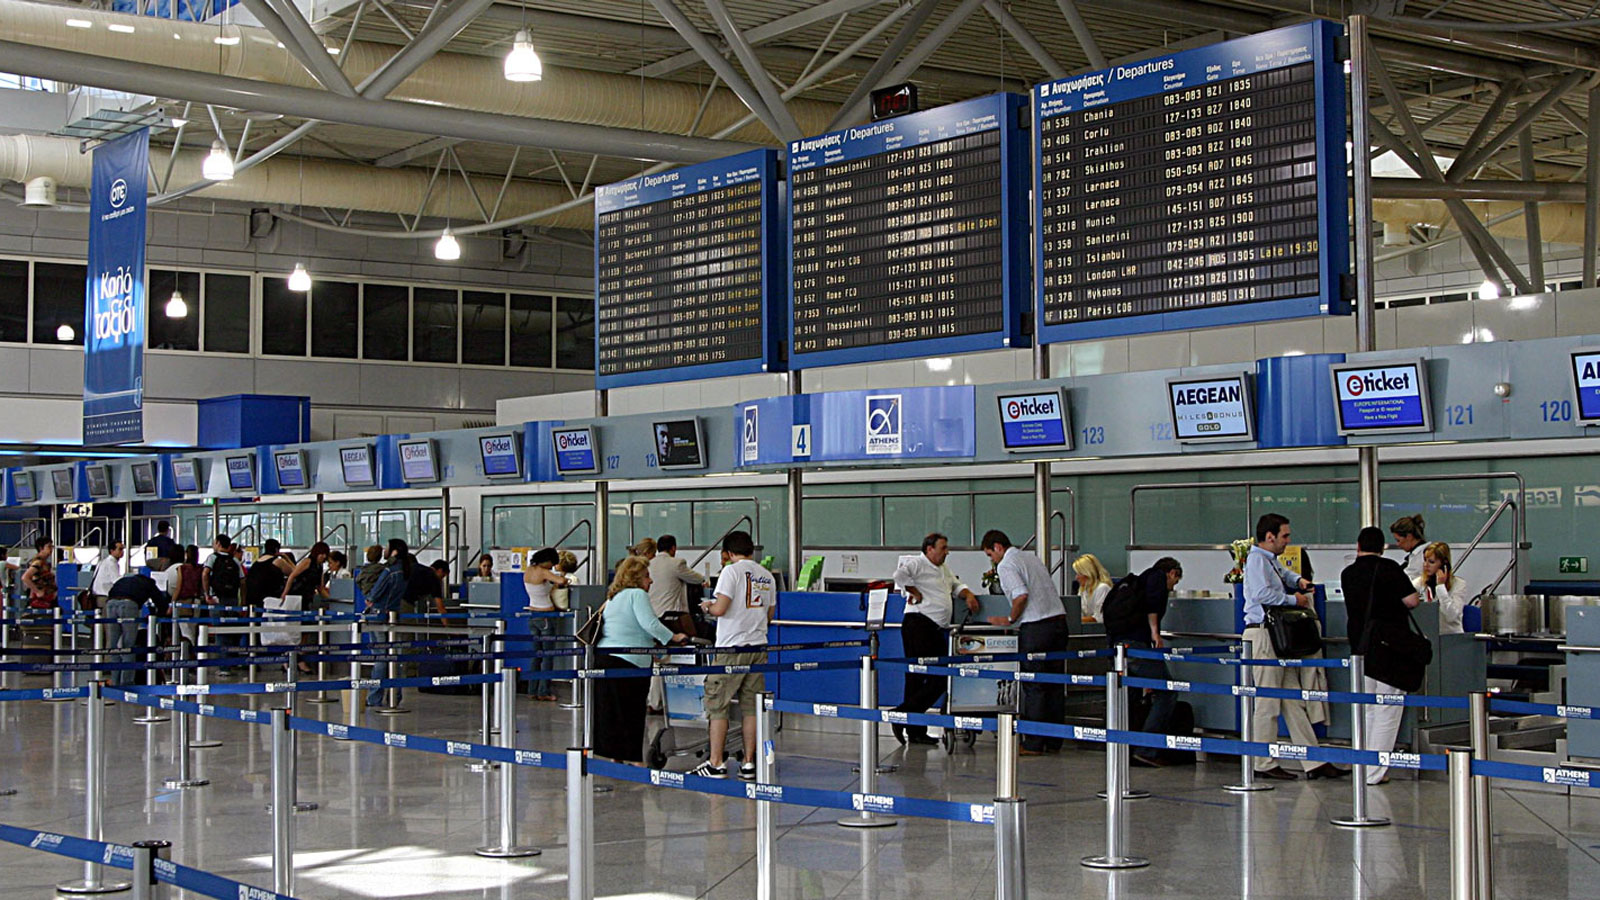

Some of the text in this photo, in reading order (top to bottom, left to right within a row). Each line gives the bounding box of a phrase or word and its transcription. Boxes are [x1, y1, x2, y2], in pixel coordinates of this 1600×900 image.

[1052, 74, 1104, 95] Αναχωρήσεις
[1117, 59, 1174, 80] Departures
[1055, 116, 1069, 128] 536
[1084, 107, 1113, 123] Chania
[1163, 88, 1201, 106] 083-083
[1229, 78, 1250, 93] 1835
[1055, 133, 1069, 146] 406
[1084, 125, 1108, 140] Corfu
[1164, 107, 1201, 124] 127-133
[1229, 97, 1251, 111] 1840
[850, 122, 894, 140] Departures
[1055, 151, 1070, 163] 514
[1084, 140, 1123, 157] Iraklion
[1164, 125, 1201, 142] 083-083
[1230, 116, 1251, 130] 1840
[886, 149, 914, 164] 127-133
[1055, 168, 1070, 180] 782
[1084, 158, 1124, 175] Skiathos
[1164, 144, 1202, 161] 083-083
[1230, 134, 1251, 149] 1840
[644, 172, 679, 187] Departures
[886, 165, 915, 180] 104-104
[1056, 185, 1070, 198] 337
[1085, 177, 1119, 193] Larnaca
[1165, 162, 1202, 179] 050-054
[1230, 153, 1252, 167] 1845
[1056, 203, 1070, 215] 331
[1085, 195, 1119, 210] Larnaca
[1165, 181, 1203, 197] 079-094
[1231, 172, 1252, 186] 1845
[1056, 220, 1076, 232] 3218
[1085, 213, 1115, 228] Munich
[1166, 199, 1203, 215] 145-151
[1231, 191, 1253, 205] 1855
[1056, 238, 1071, 250] 358
[1086, 229, 1130, 245] Santorini
[1167, 218, 1203, 233] 127-133
[1232, 210, 1253, 224] 1900
[1057, 255, 1071, 267] 319
[1086, 248, 1125, 263] Istanbul
[1166, 236, 1204, 252] 079-094
[1232, 229, 1254, 243] 1900
[887, 262, 916, 275] 127-133
[1057, 273, 1072, 284] 633
[1086, 267, 1116, 281] London
[1167, 255, 1204, 270] 042-046
[1233, 248, 1254, 262] 1905
[1260, 245, 1283, 258] Late
[1289, 240, 1317, 254] 19:30
[100, 266, 132, 300] Καλό
[1057, 291, 1072, 302] 378
[1086, 284, 1121, 298] Mykonos
[1168, 274, 1205, 289] 127-133
[1233, 268, 1255, 281] 1910
[826, 302, 860, 315] Frankfurt
[888, 295, 916, 307] 145-151
[1087, 304, 1111, 316] Paris
[1168, 293, 1205, 307] 111-114
[1233, 287, 1255, 300] 1910
[95, 295, 136, 344] ταξίδι
[826, 316, 872, 330] Thessaloniki
[1176, 386, 1240, 405] AEGEAN
[1446, 404, 1474, 426] 121
[1540, 400, 1572, 422] 120
[797, 427, 806, 453] 4
[1082, 426, 1105, 445] 123
[1150, 422, 1172, 440] 122
[607, 455, 620, 469] 127
[986, 638, 1017, 647] Greece
[888, 711, 908, 719] ATHENS
[1566, 706, 1591, 714] ATHENS
[962, 716, 982, 724] ATHENS
[390, 732, 406, 742] ATHENS
[1083, 727, 1107, 736] ATHENS
[1176, 736, 1201, 745] ATHENS
[453, 742, 471, 750] ATHENS
[522, 750, 541, 760] ATHENS
[1279, 744, 1307, 754] ATHENS
[1390, 752, 1420, 761] ATHENS
[659, 770, 684, 781] ATHENS
[1556, 768, 1589, 779] ATHENS
[755, 783, 782, 794] ATHENS
[864, 794, 893, 805] ATHENS
[43, 833, 64, 844] ATHENS
